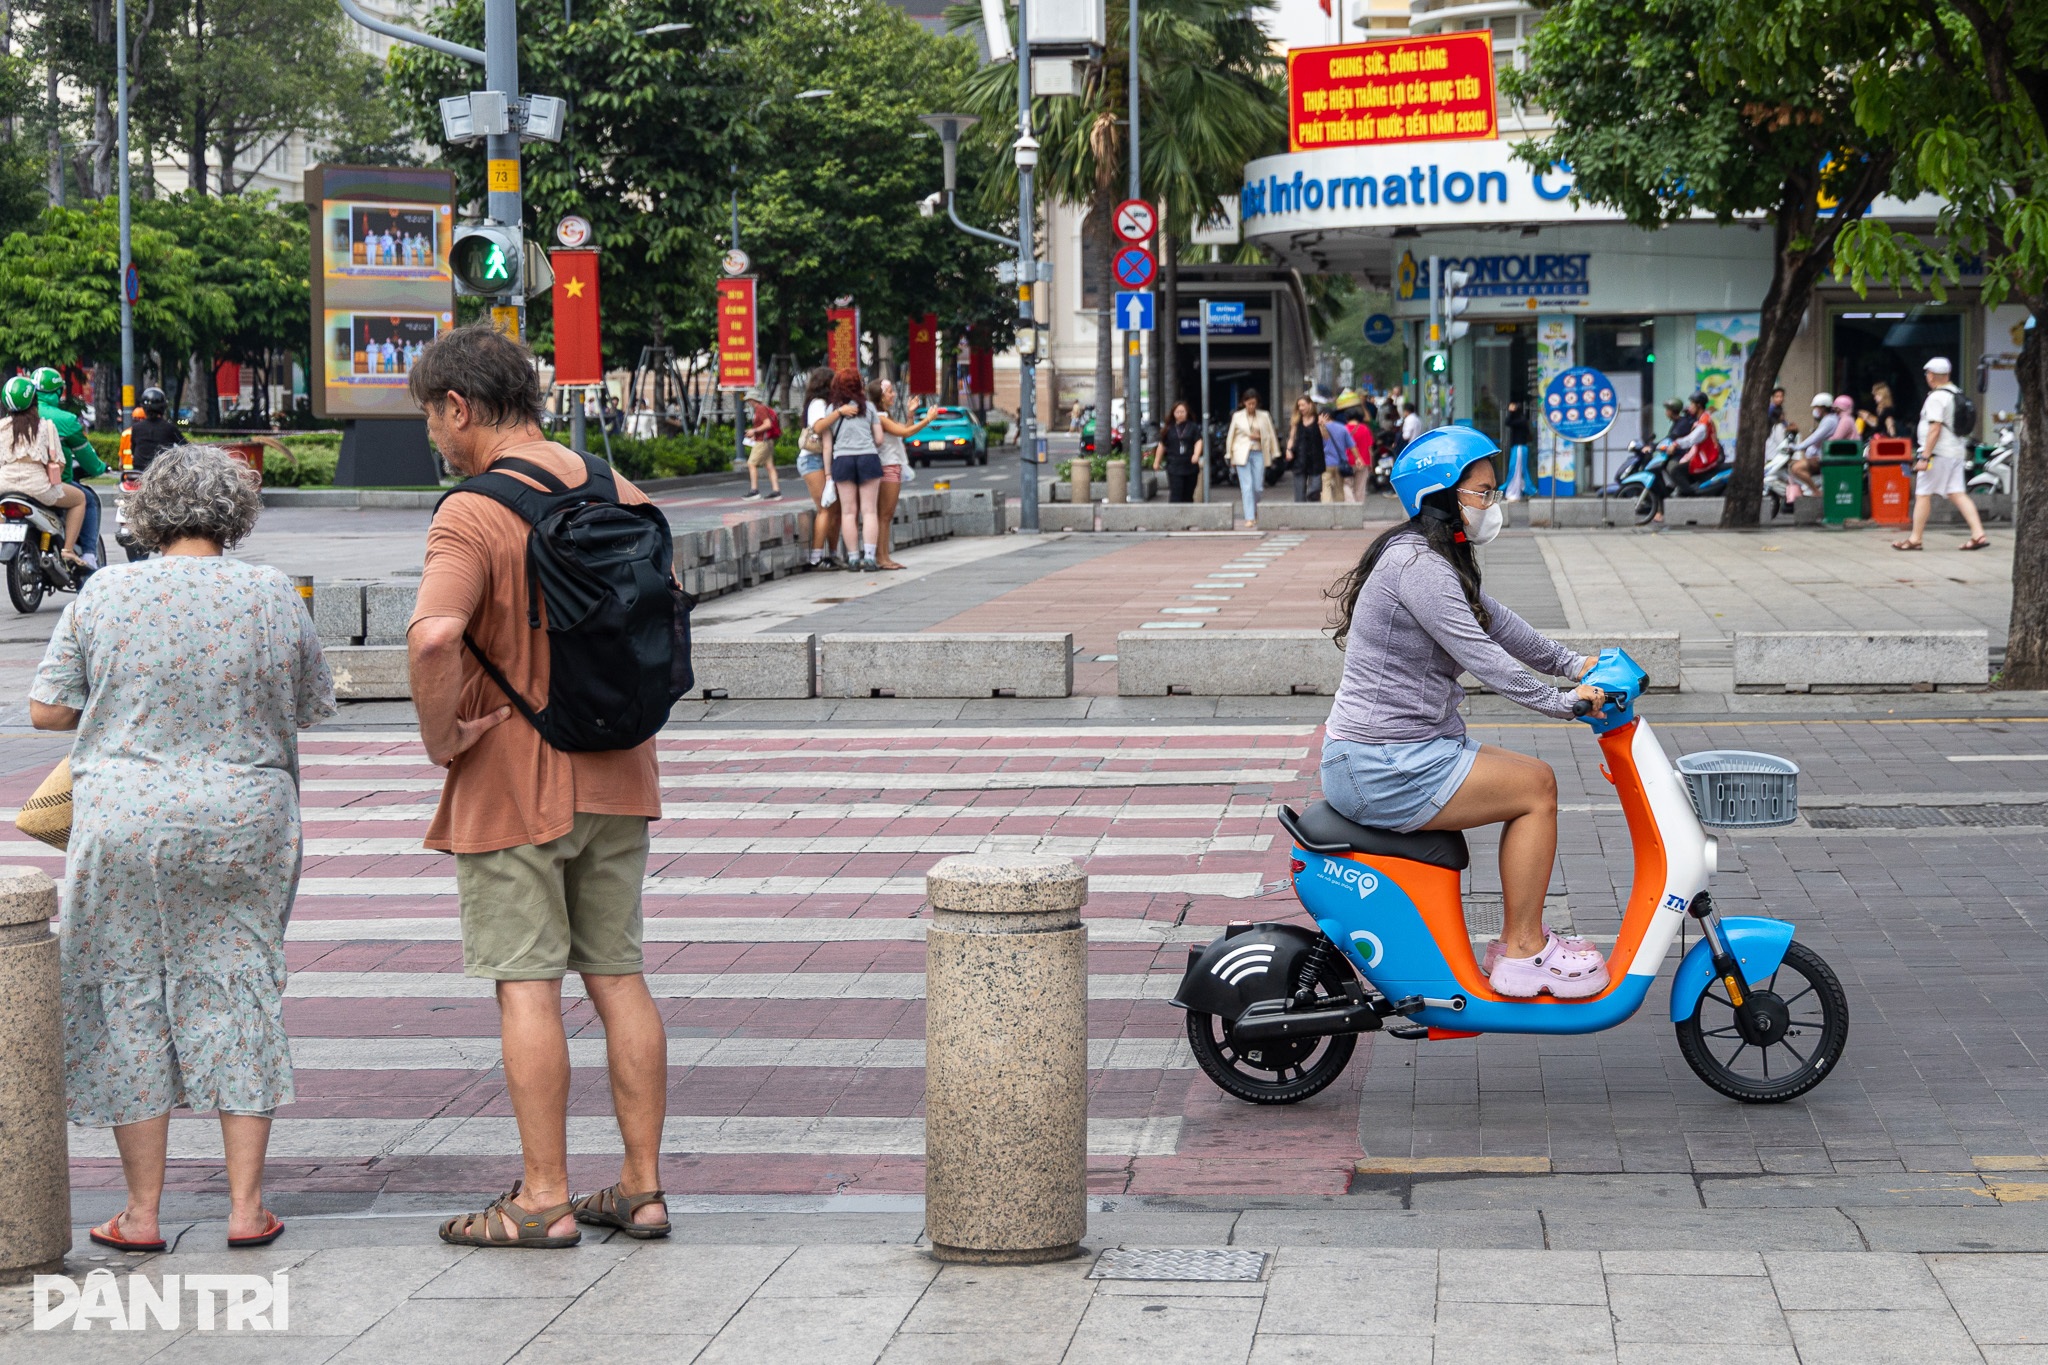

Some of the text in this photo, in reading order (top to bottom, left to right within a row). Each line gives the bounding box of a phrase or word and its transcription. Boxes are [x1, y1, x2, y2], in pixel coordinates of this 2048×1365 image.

[1329, 46, 1448, 79] CHUNG SỨC, ĐỒNG LÒNG
[1302, 74, 1481, 115] THỰC HIỆN THẮNG LỢI CÁC MỤC TIÊU
[1298, 108, 1488, 144] PHÁT TRIỂN ĐẤT NƯỚC ĐẾN NĂM 2030!
[495, 171, 508, 182] 73
[1270, 165, 1508, 214] Information
[1505, 284, 1585, 296] SERVICE
[1416, 456, 1433, 469] TN
[1667, 893, 1689, 911] TN
